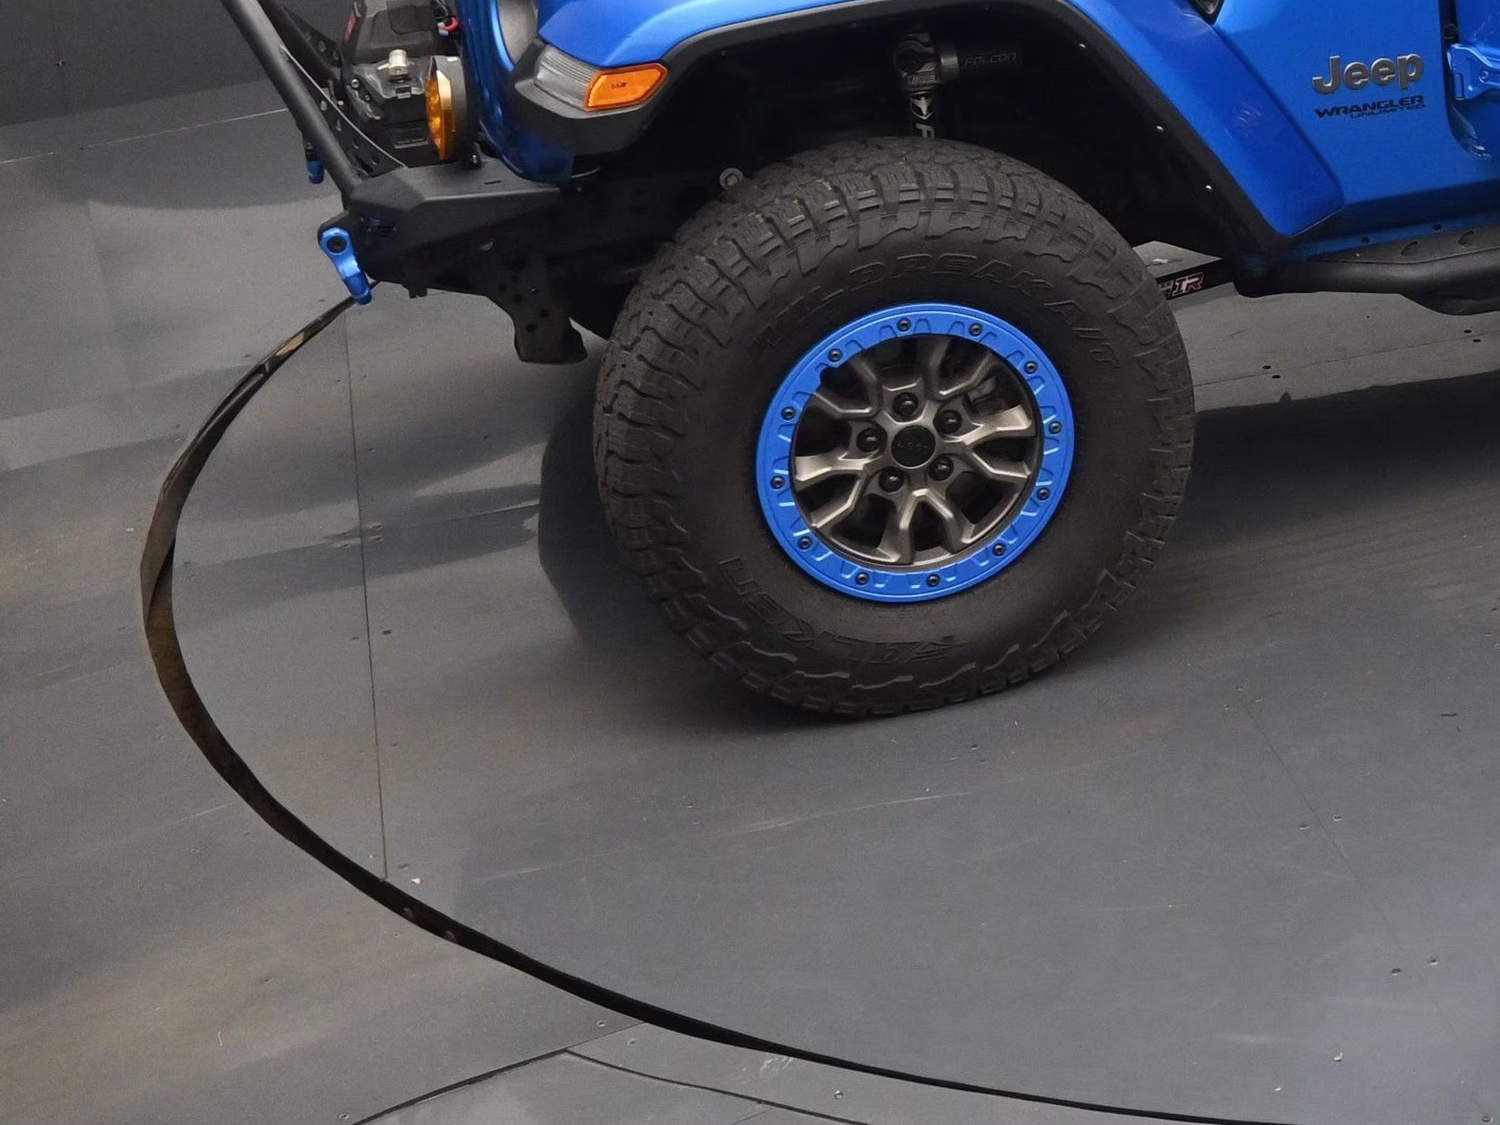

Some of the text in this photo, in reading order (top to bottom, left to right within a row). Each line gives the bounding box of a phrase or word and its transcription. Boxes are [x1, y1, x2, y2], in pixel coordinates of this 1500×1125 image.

[1312, 53, 1424, 94] Jeep
[1314, 95, 1424, 118] WRANGLER
[1350, 103, 1425, 119] UNLIMITED
